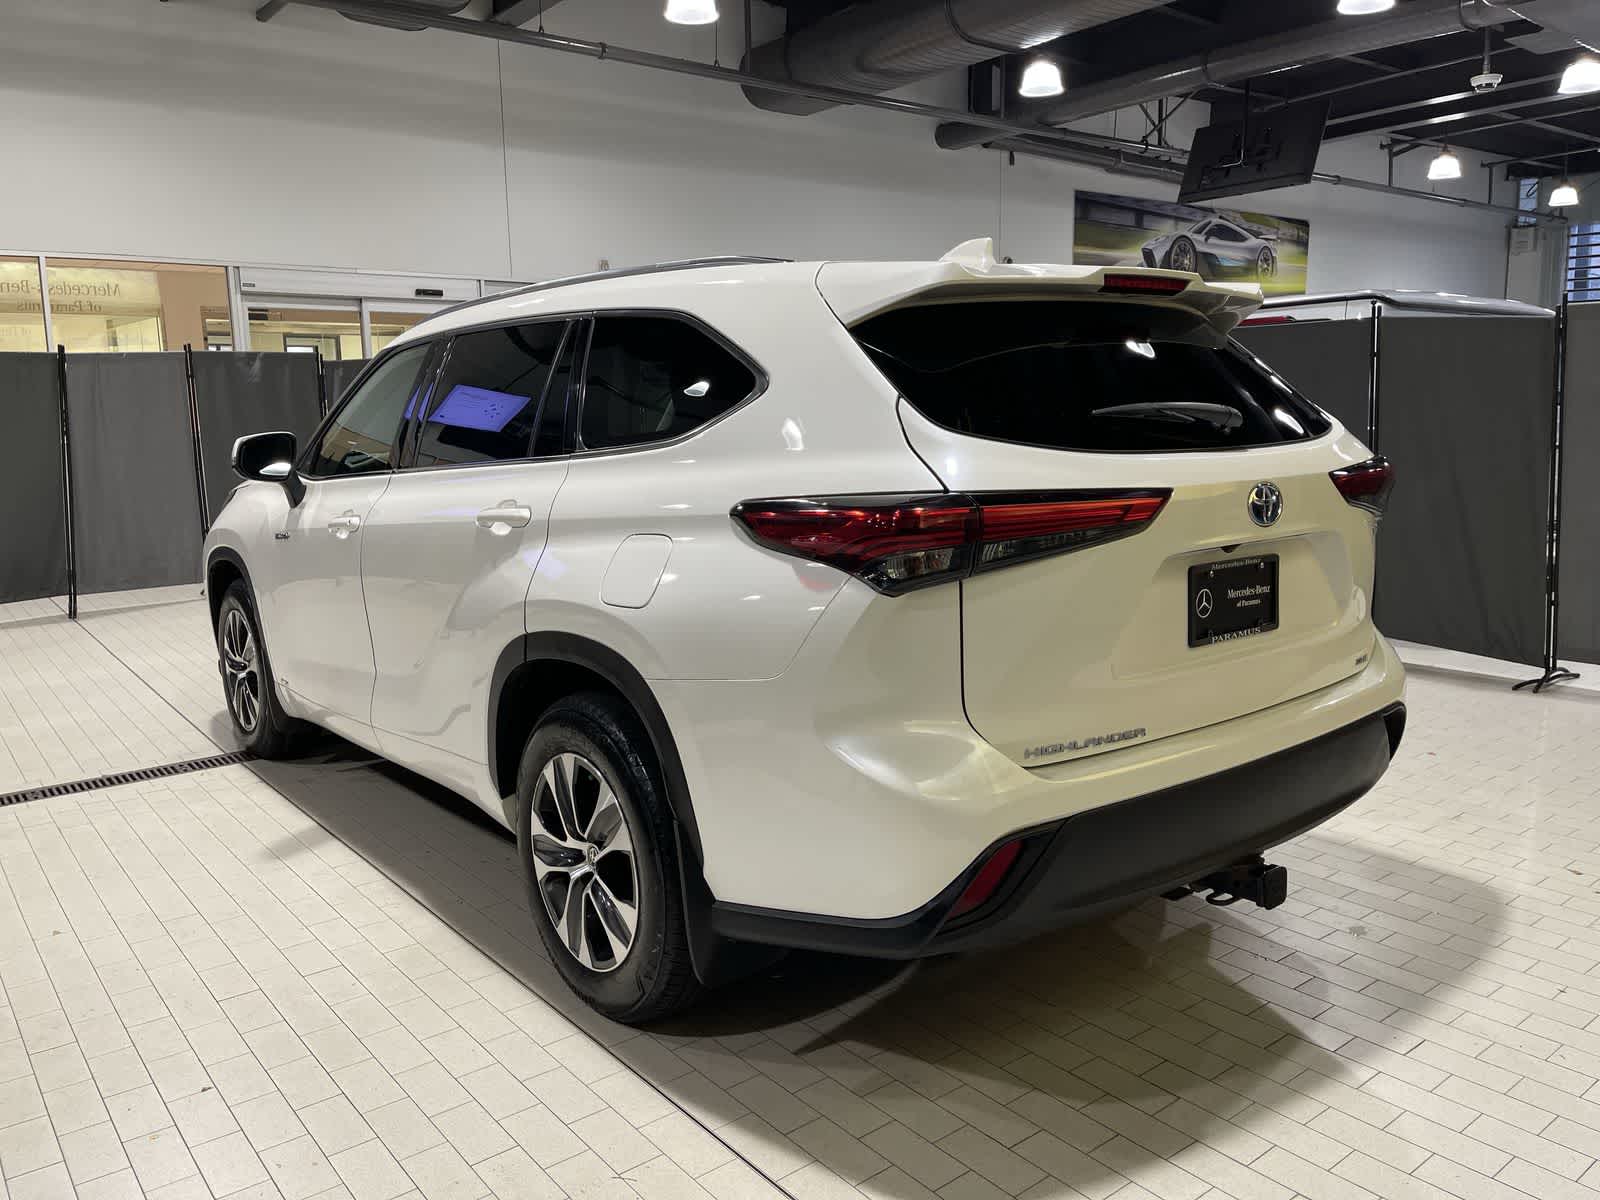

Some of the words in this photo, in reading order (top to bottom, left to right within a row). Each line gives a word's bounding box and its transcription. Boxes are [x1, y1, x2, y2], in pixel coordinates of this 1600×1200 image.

[1228, 585, 1271, 599] Mercedes-Benz
[1212, 627, 1261, 643] PARAMUS
[1024, 727, 1147, 759] HIGHLANDER
